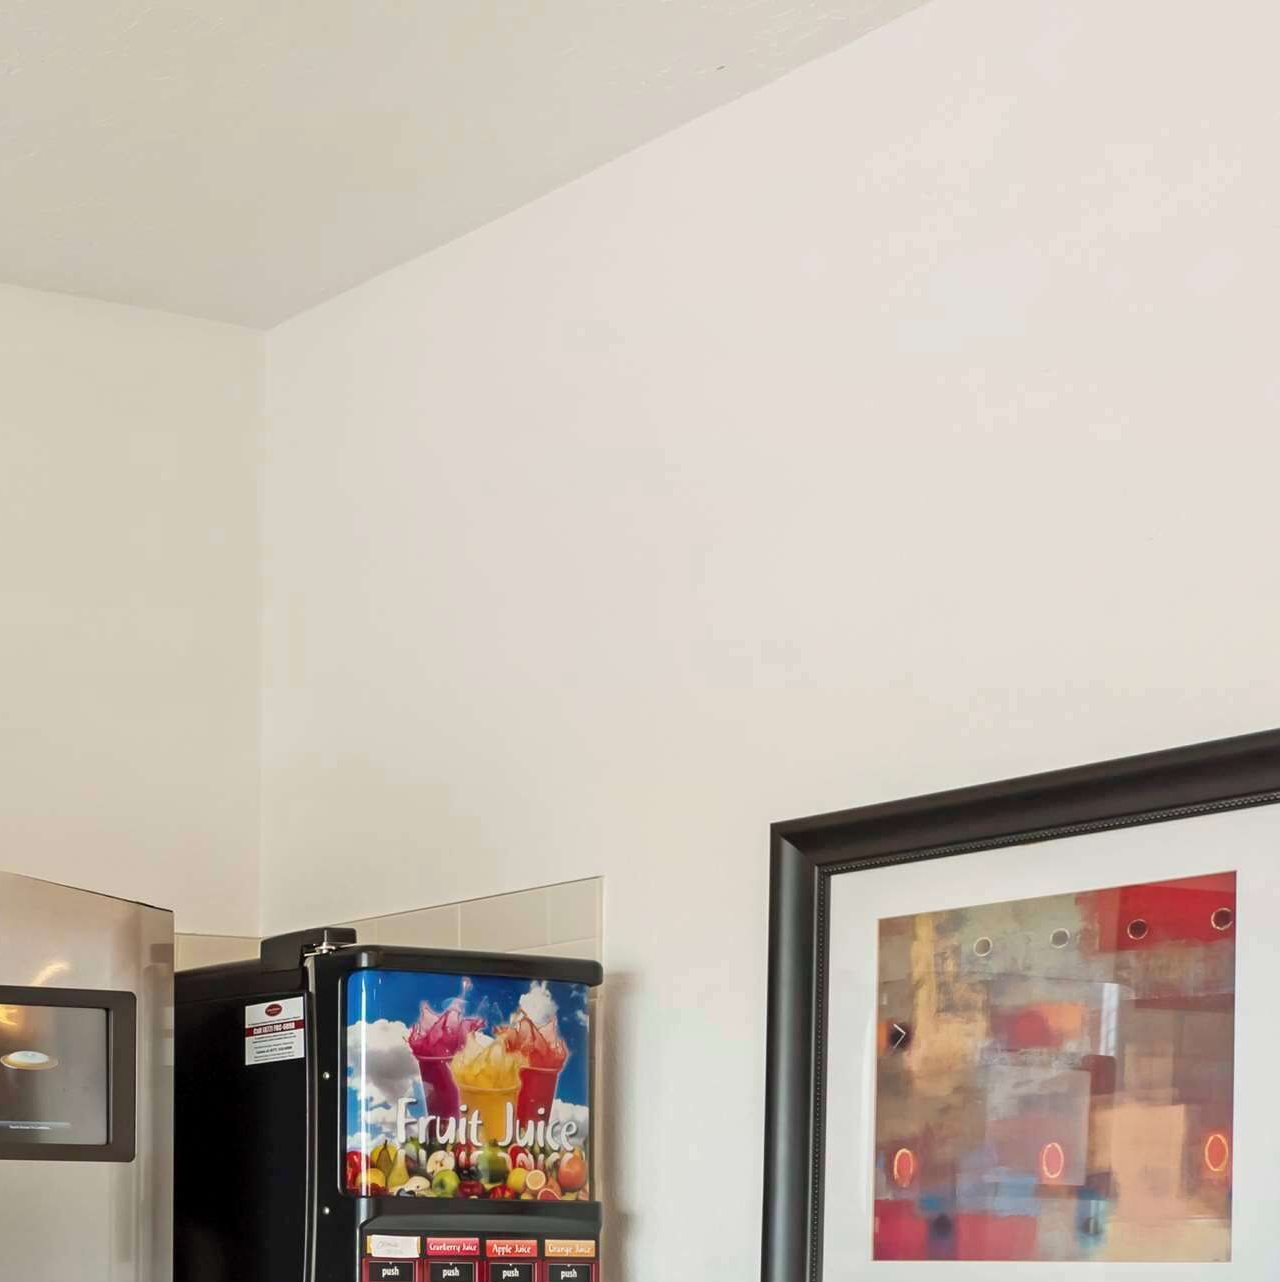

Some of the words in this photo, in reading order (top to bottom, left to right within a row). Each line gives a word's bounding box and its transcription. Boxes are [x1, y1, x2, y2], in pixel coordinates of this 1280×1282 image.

[396, 1096, 483, 1147] Fruit
[497, 1101, 579, 1152] Juice
[429, 1242, 461, 1252] Cranberry
[462, 1242, 477, 1251] Juice
[492, 1243, 512, 1255] Apple
[514, 1244, 531, 1253] Juice
[382, 1265, 399, 1278] push
[442, 1266, 460, 1279] push
[502, 1267, 520, 1280] push
[560, 1268, 577, 1280] push
